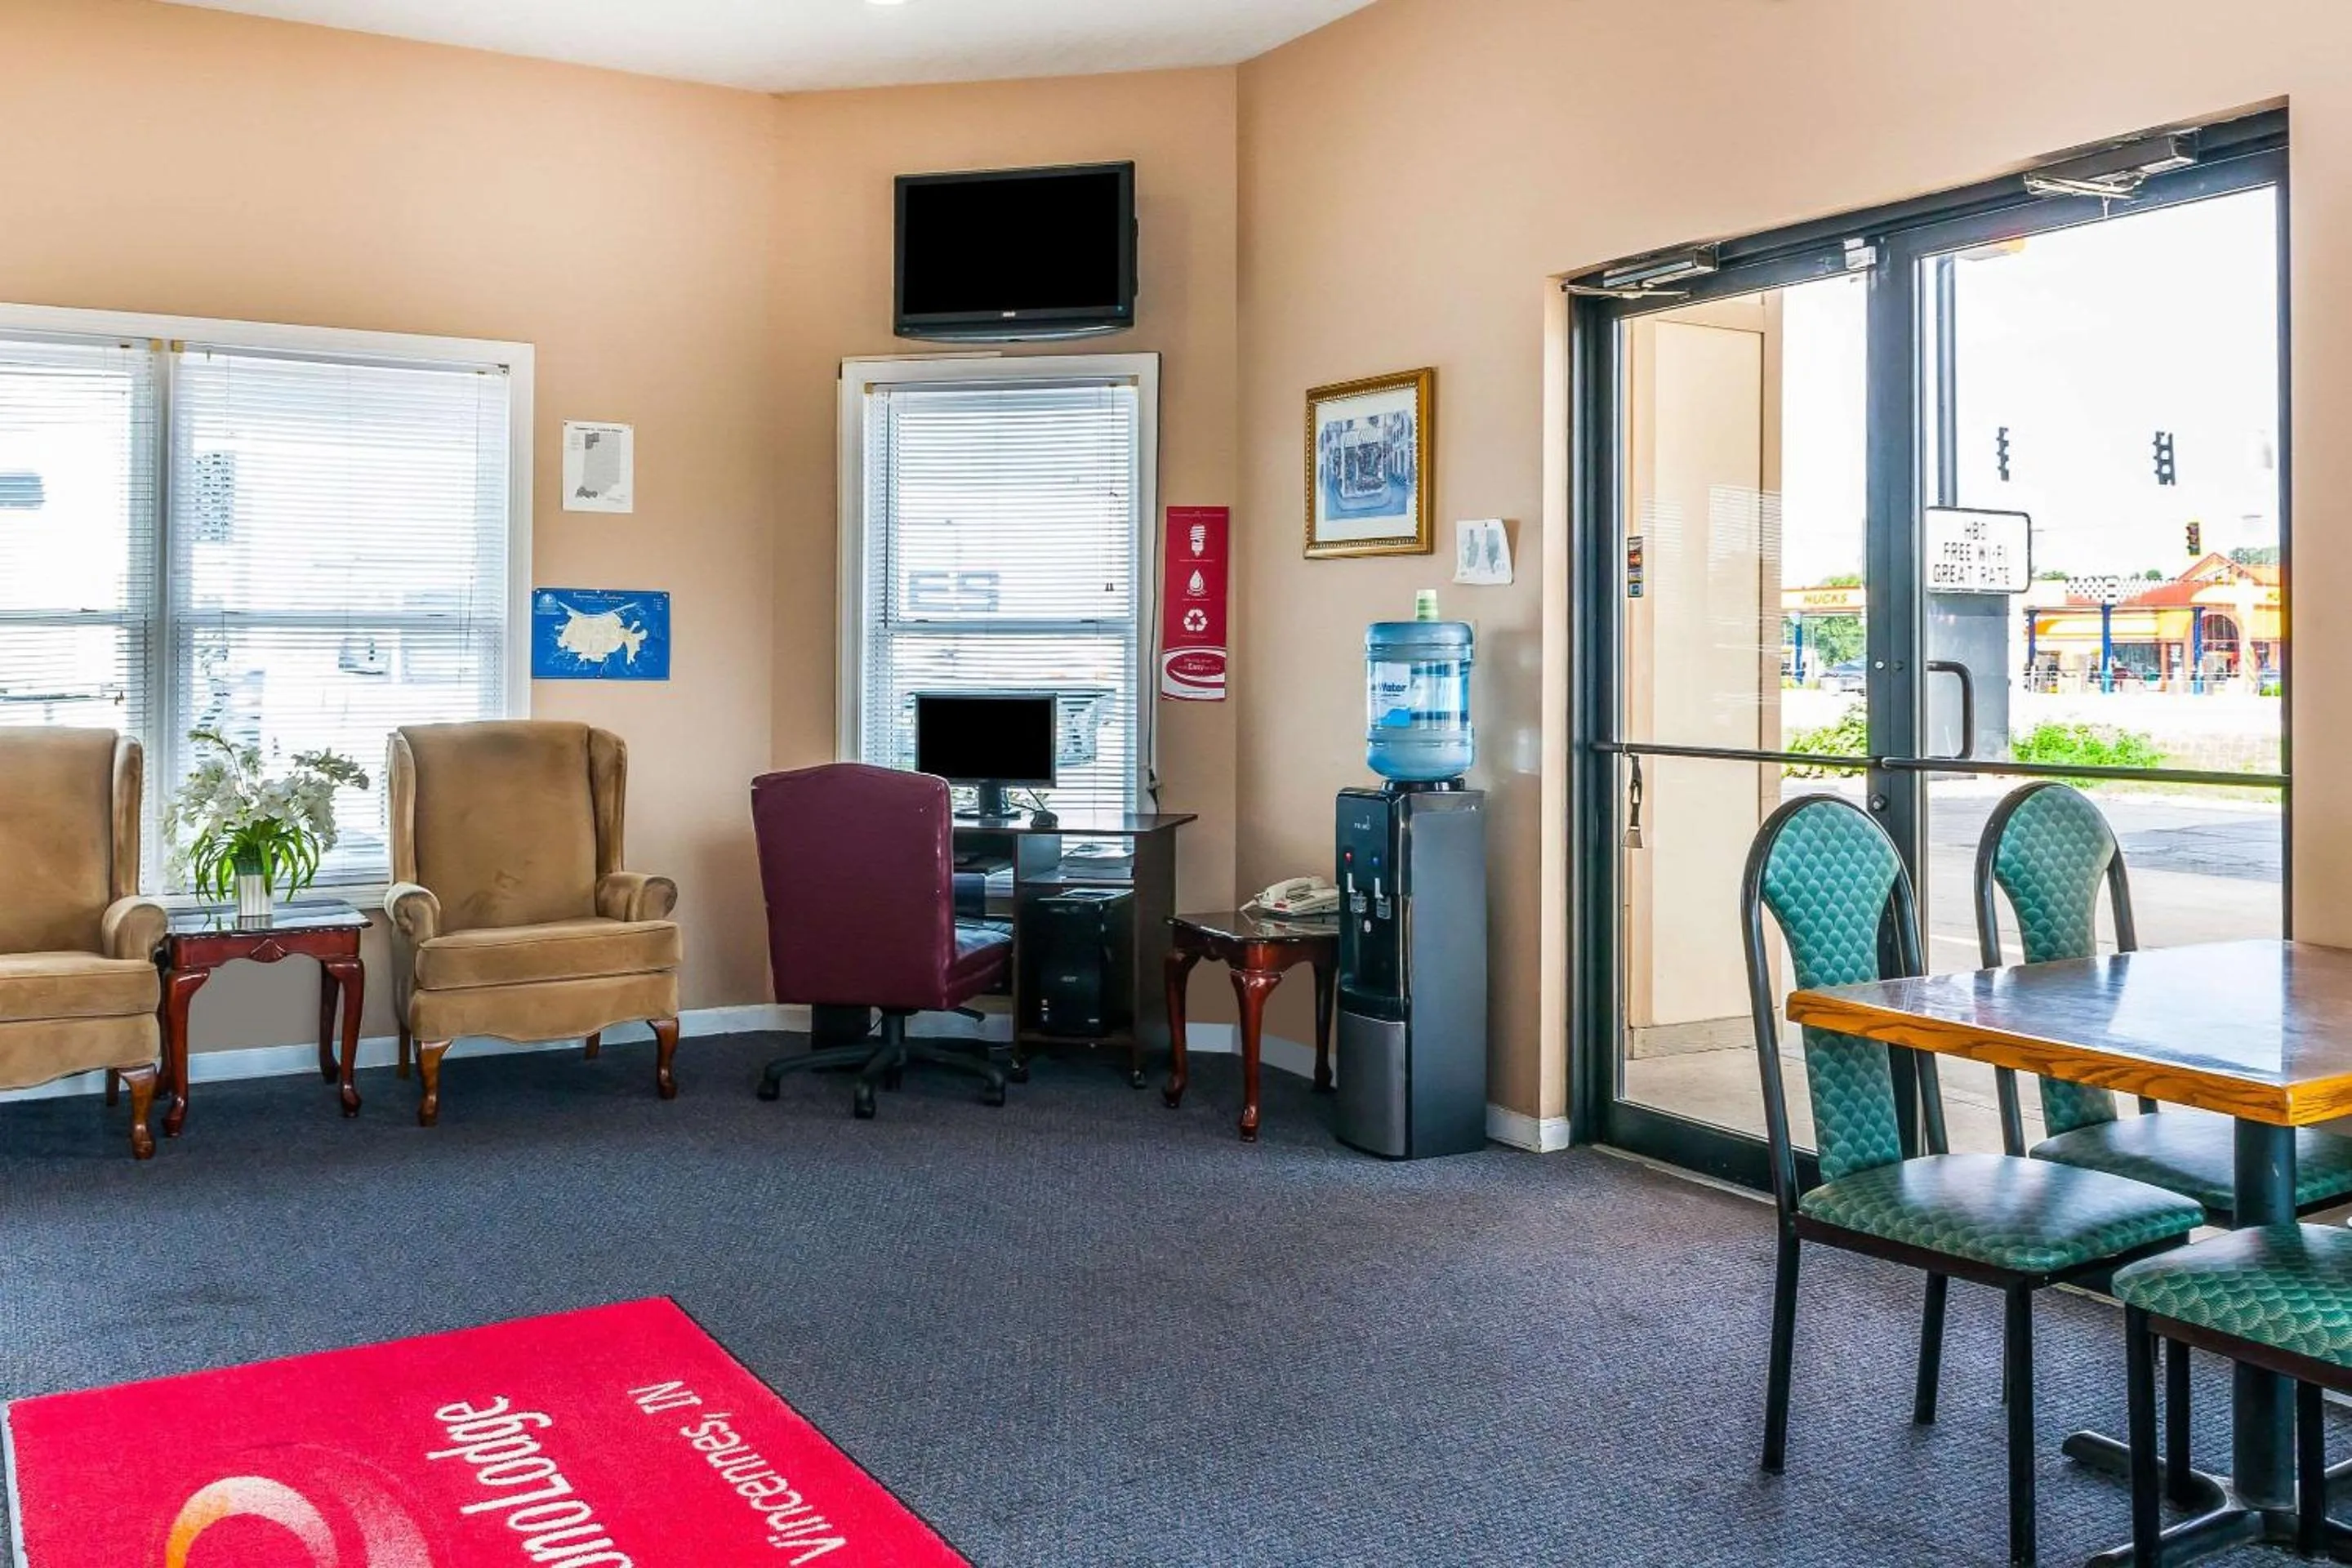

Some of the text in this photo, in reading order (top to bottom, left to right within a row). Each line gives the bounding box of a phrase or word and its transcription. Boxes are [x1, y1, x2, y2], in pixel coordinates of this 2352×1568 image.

[1944, 541, 1971, 561] FREE
[1933, 564, 1973, 585] GREAT
[626, 1380, 847, 1566] Vincennes, IN
